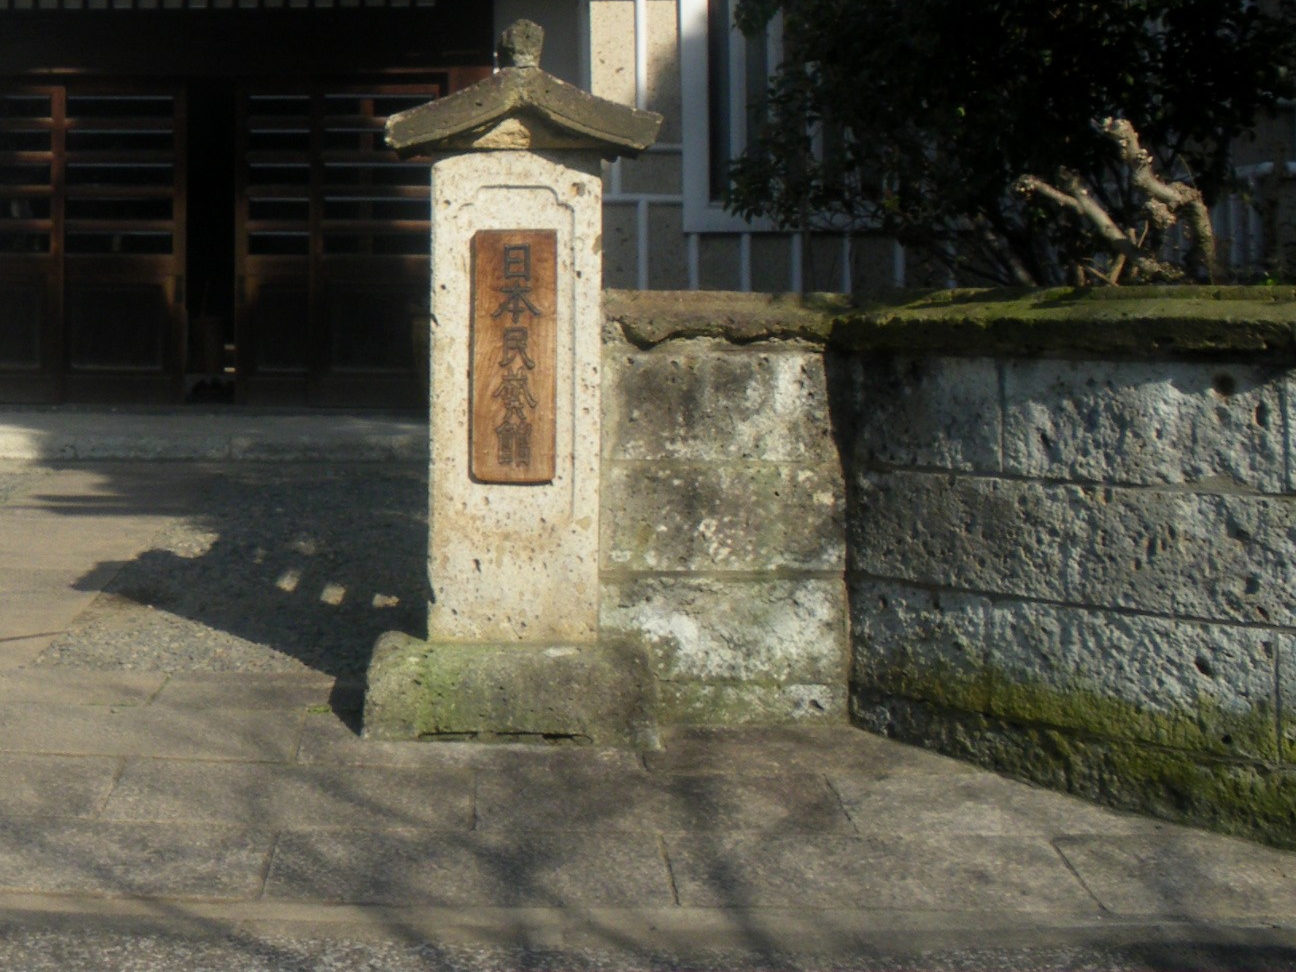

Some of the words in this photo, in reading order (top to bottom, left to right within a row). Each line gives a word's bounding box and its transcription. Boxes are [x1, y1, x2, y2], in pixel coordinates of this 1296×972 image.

[491, 243, 540, 467] 日本民藝館
